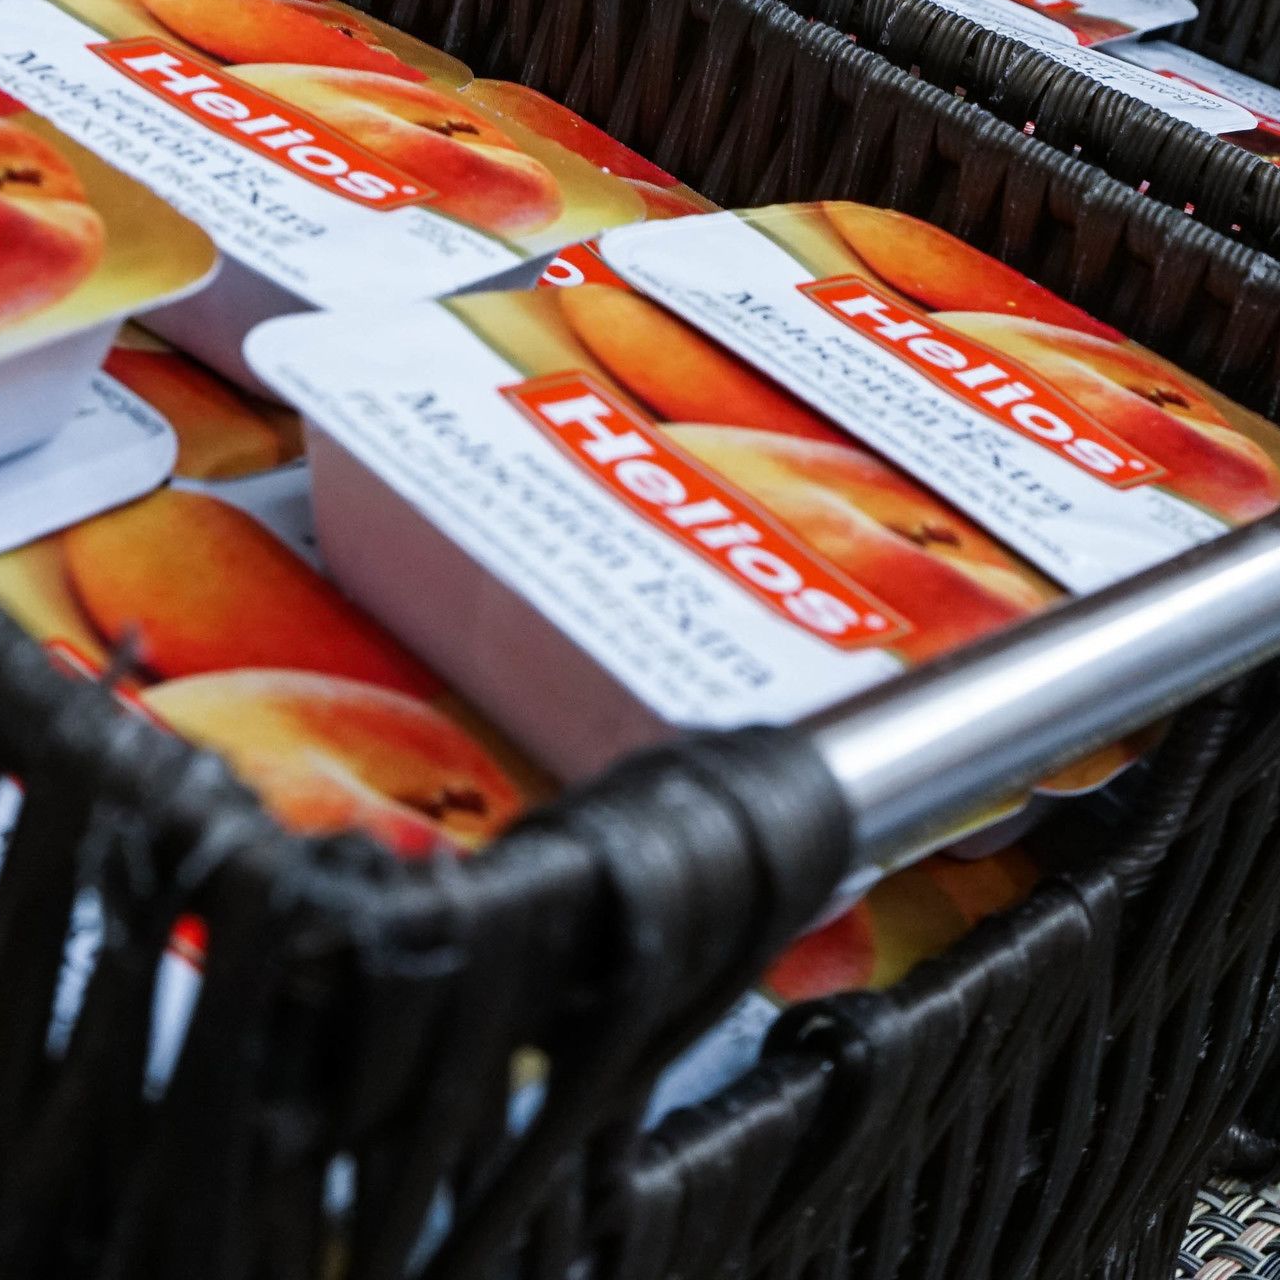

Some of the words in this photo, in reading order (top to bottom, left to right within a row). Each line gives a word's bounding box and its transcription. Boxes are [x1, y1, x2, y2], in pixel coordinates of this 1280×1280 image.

[122, 52, 397, 201] Helios
[212, 168, 327, 237] Extra
[831, 294, 1126, 476] Helios
[538, 394, 865, 638] Helios
